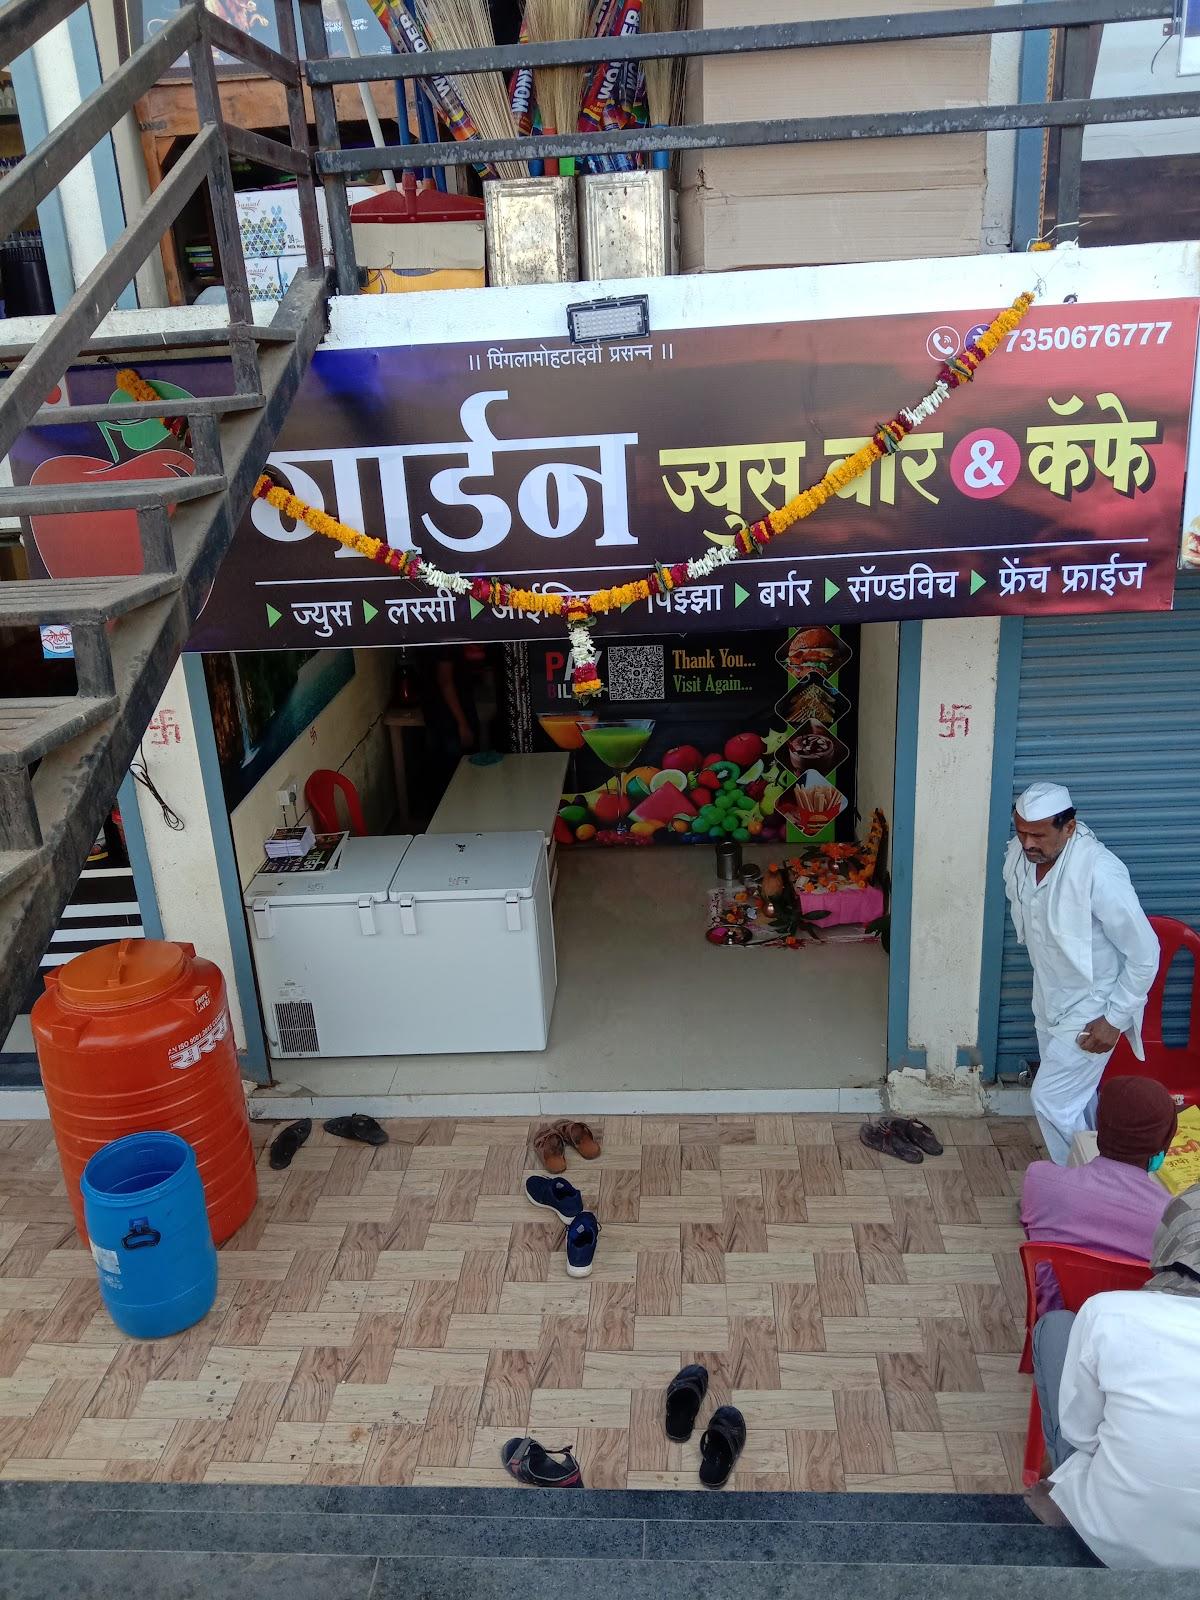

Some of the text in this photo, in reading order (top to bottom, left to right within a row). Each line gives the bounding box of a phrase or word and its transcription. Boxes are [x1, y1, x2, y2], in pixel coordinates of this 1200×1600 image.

[608, 344, 653, 363] प्रसन्न
[1004, 321, 1172, 353] 7350676777
[250, 390, 639, 559] गार्डन
[963, 439, 1006, 489] &
[1026, 392, 1159, 497] कॅफे
[757, 570, 813, 607] बर्गर
[846, 563, 960, 603] सॅण्डविच
[998, 553, 1148, 598] फ्रेंच फ्राईज
[290, 600, 353, 638] ज्युस
[384, 586, 457, 627] लस्सी
[672, 648, 757, 670] Thank You...
[672, 674, 753, 694] Visit Again...
